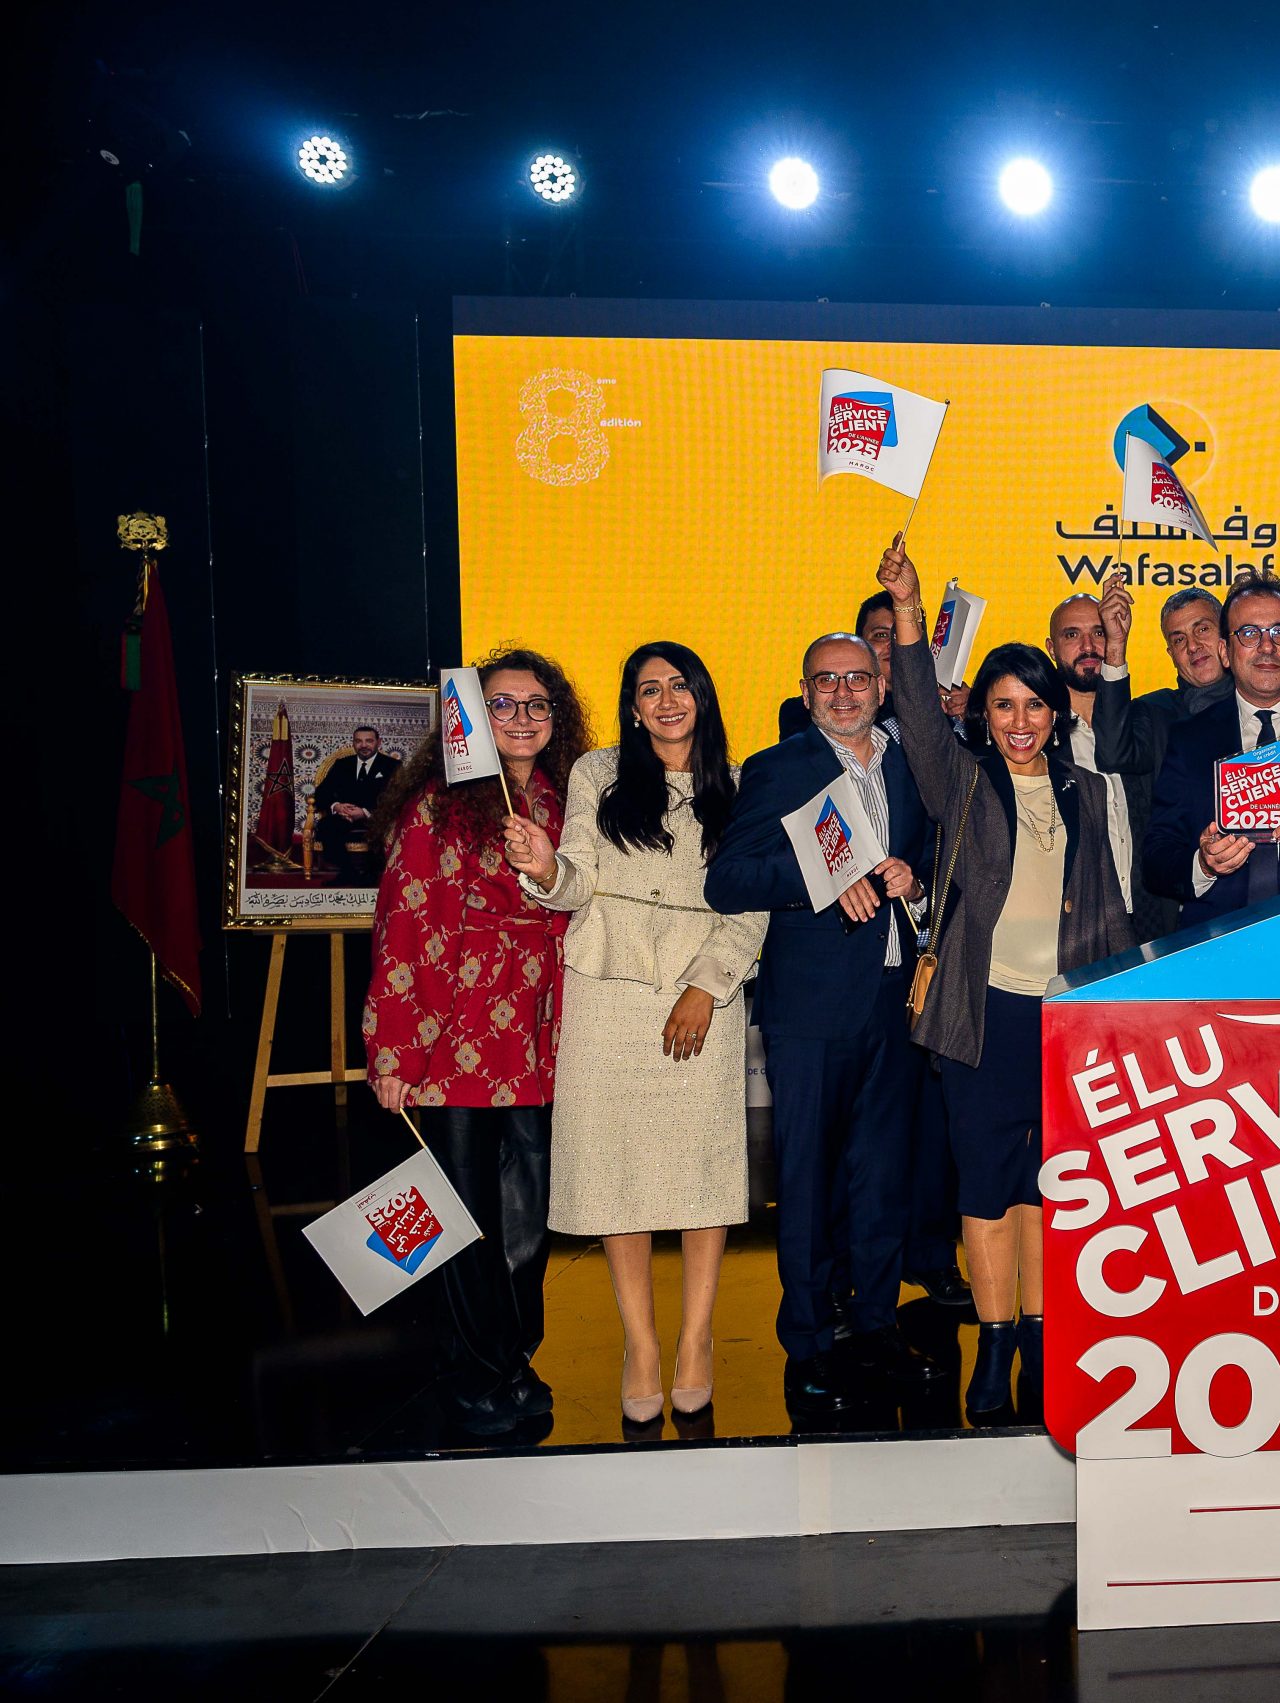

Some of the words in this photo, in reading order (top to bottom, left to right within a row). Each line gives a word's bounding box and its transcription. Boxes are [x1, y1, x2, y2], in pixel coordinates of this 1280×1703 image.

[829, 409, 887, 427] SERVICE
[833, 403, 853, 414] ÉLU
[830, 419, 887, 437] CLIENT
[828, 437, 878, 460] 2025
[848, 461, 875, 472] MAROC
[1154, 494, 1191, 517] 2025
[447, 740, 468, 759] 025
[1225, 768, 1247, 783] ÉLU
[821, 812, 839, 853] SERVICE
[825, 822, 843, 860] CLIENT
[829, 847, 853, 874] 2025
[1072, 1024, 1225, 1129] ÉLU
[368, 1186, 417, 1228] 2025
